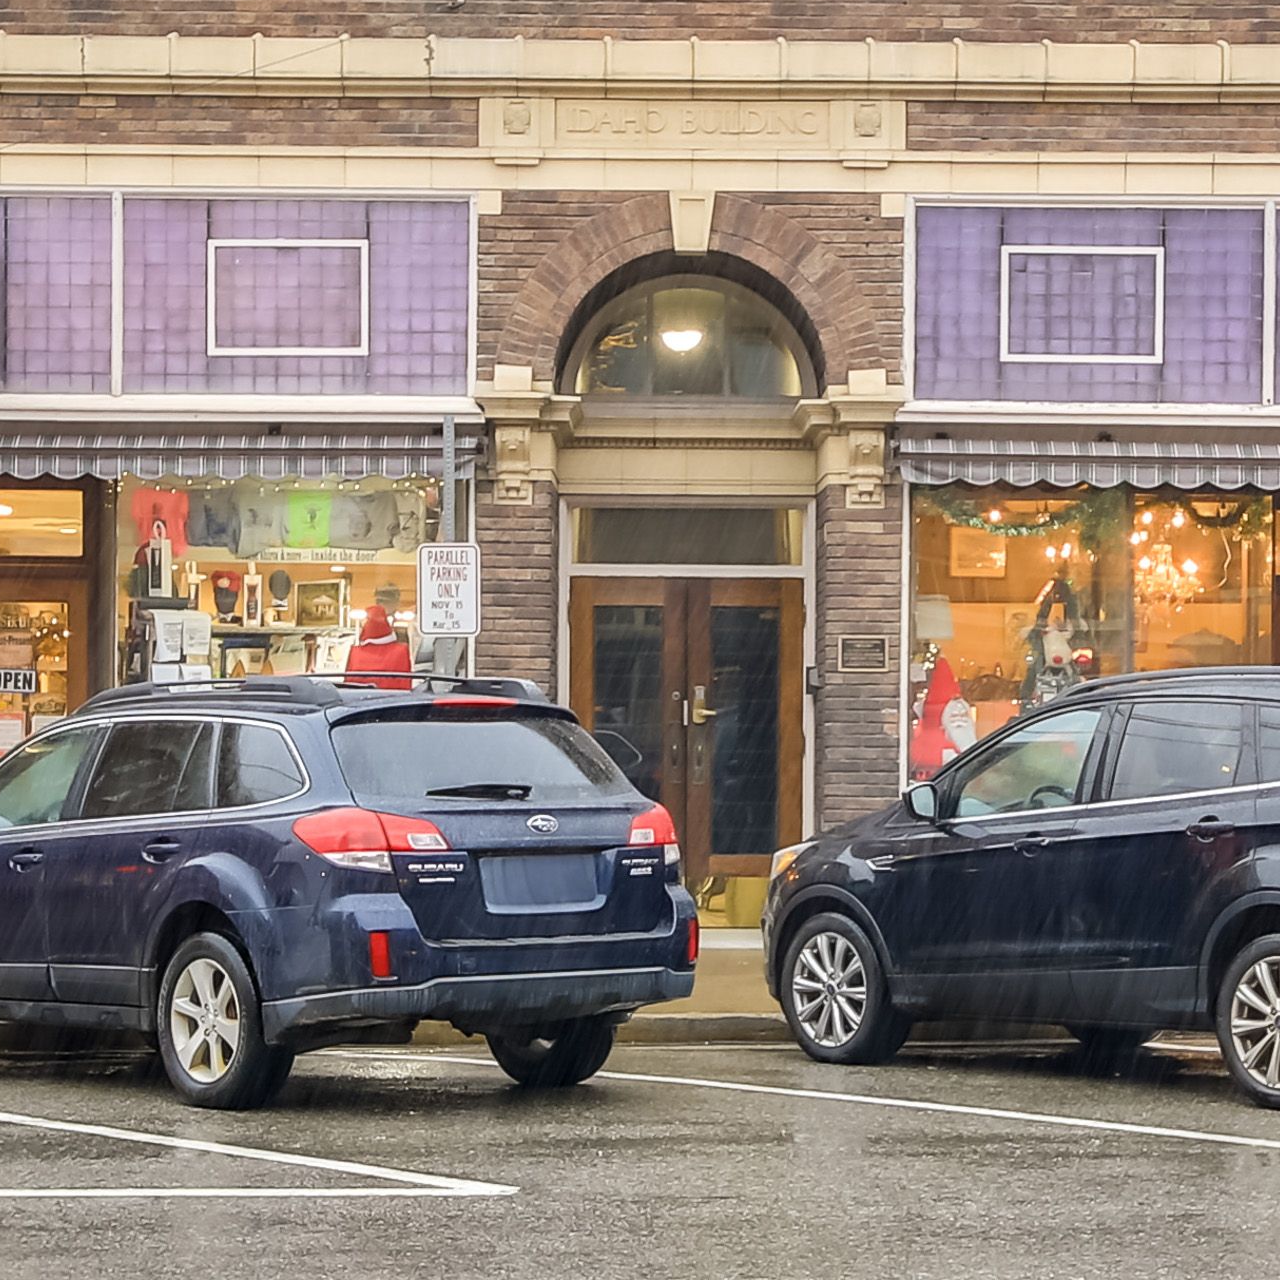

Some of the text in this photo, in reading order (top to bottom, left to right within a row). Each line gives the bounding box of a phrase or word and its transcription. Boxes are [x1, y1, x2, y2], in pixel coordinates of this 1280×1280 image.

[566, 108, 818, 135] IDAHO BUILDING
[427, 550, 471, 566] PARALLEL
[430, 566, 468, 582] PARKING
[437, 583, 460, 598] ONLY
